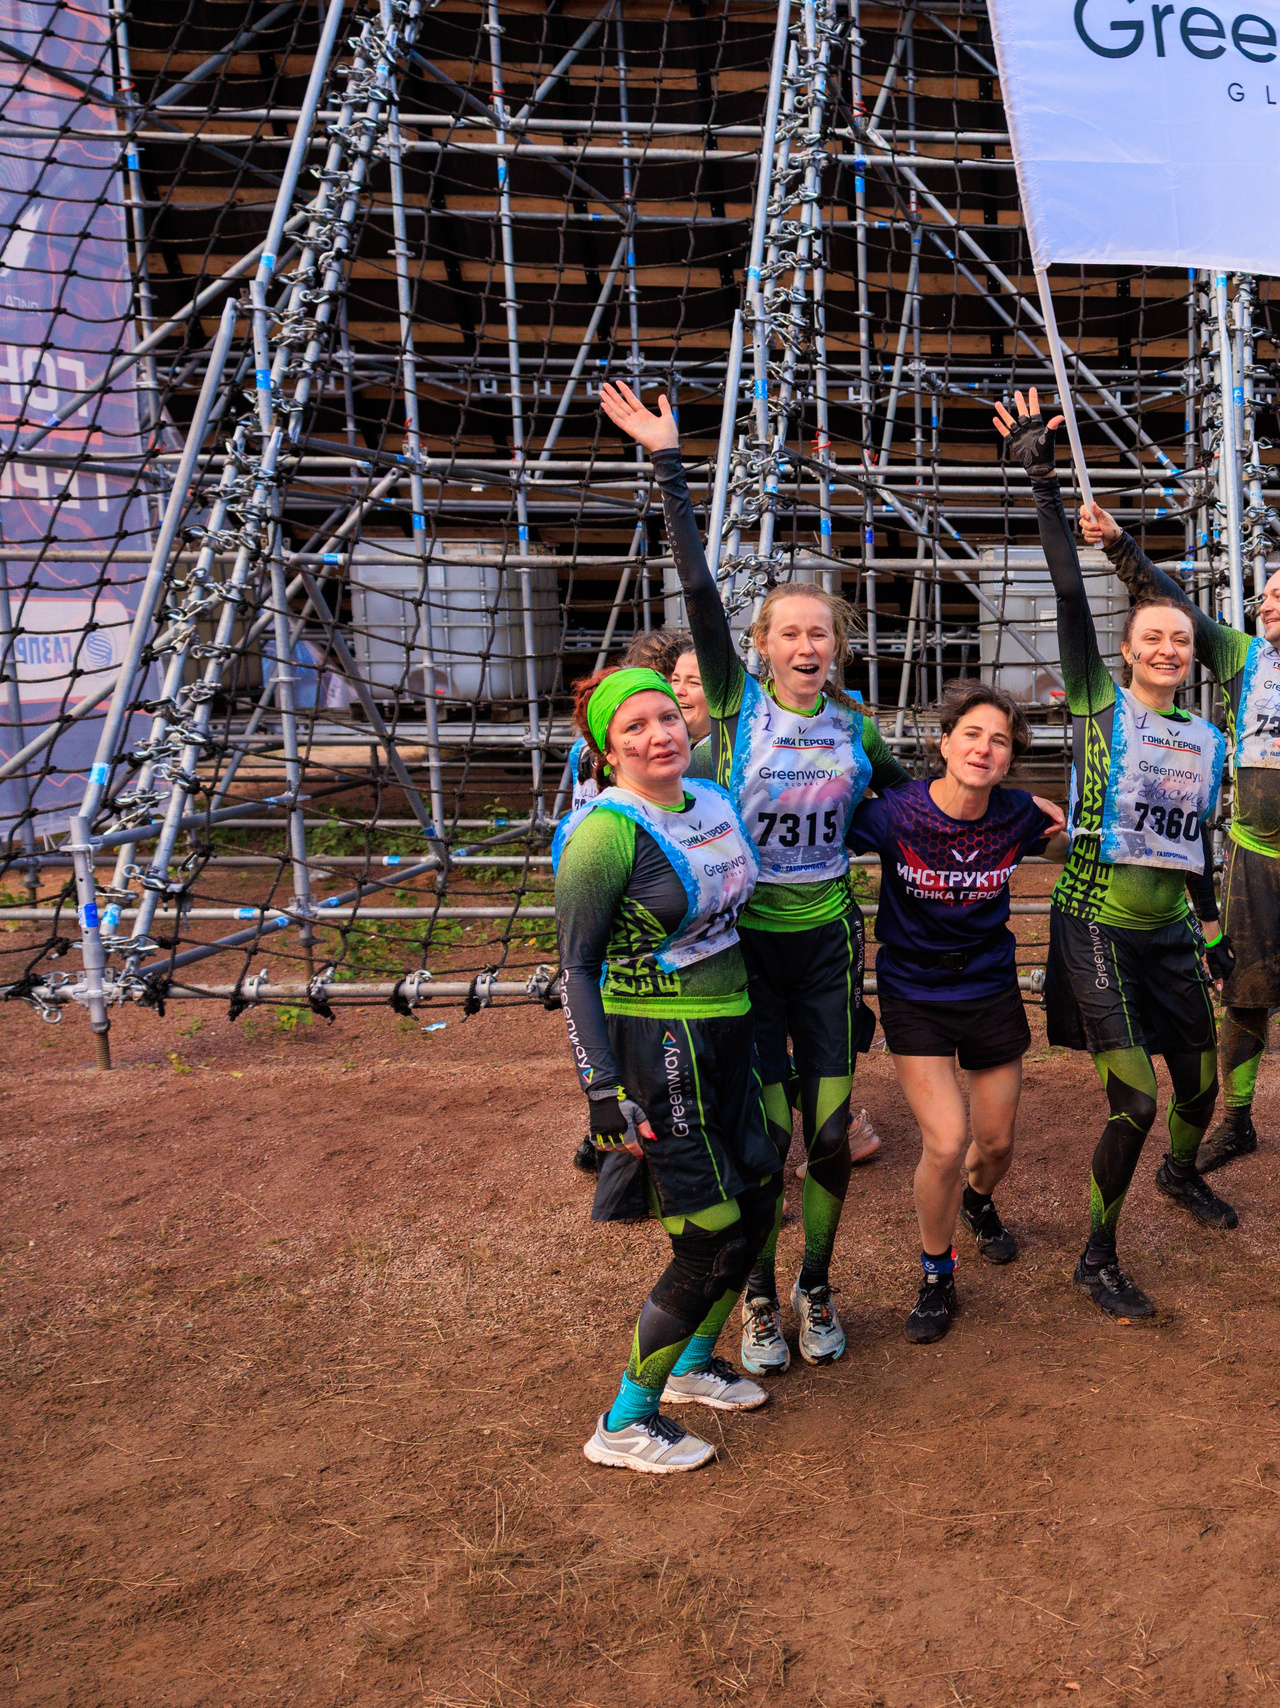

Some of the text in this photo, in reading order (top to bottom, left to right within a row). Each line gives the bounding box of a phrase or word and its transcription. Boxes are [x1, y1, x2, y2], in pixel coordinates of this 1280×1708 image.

[798, 738, 835, 747] ГЕРОЕВ
[1142, 734, 1201, 753] ГОНКА ГЕРОЕВ
[759, 767, 833, 783] Greenway
[1138, 760, 1198, 783] Greenway
[757, 810, 838, 848] 7315
[1134, 801, 1200, 842] 7360
[906, 885, 955, 900] ГОНКА
[560, 969, 591, 1069] Greenway
[664, 1046, 689, 1138] Greenway
